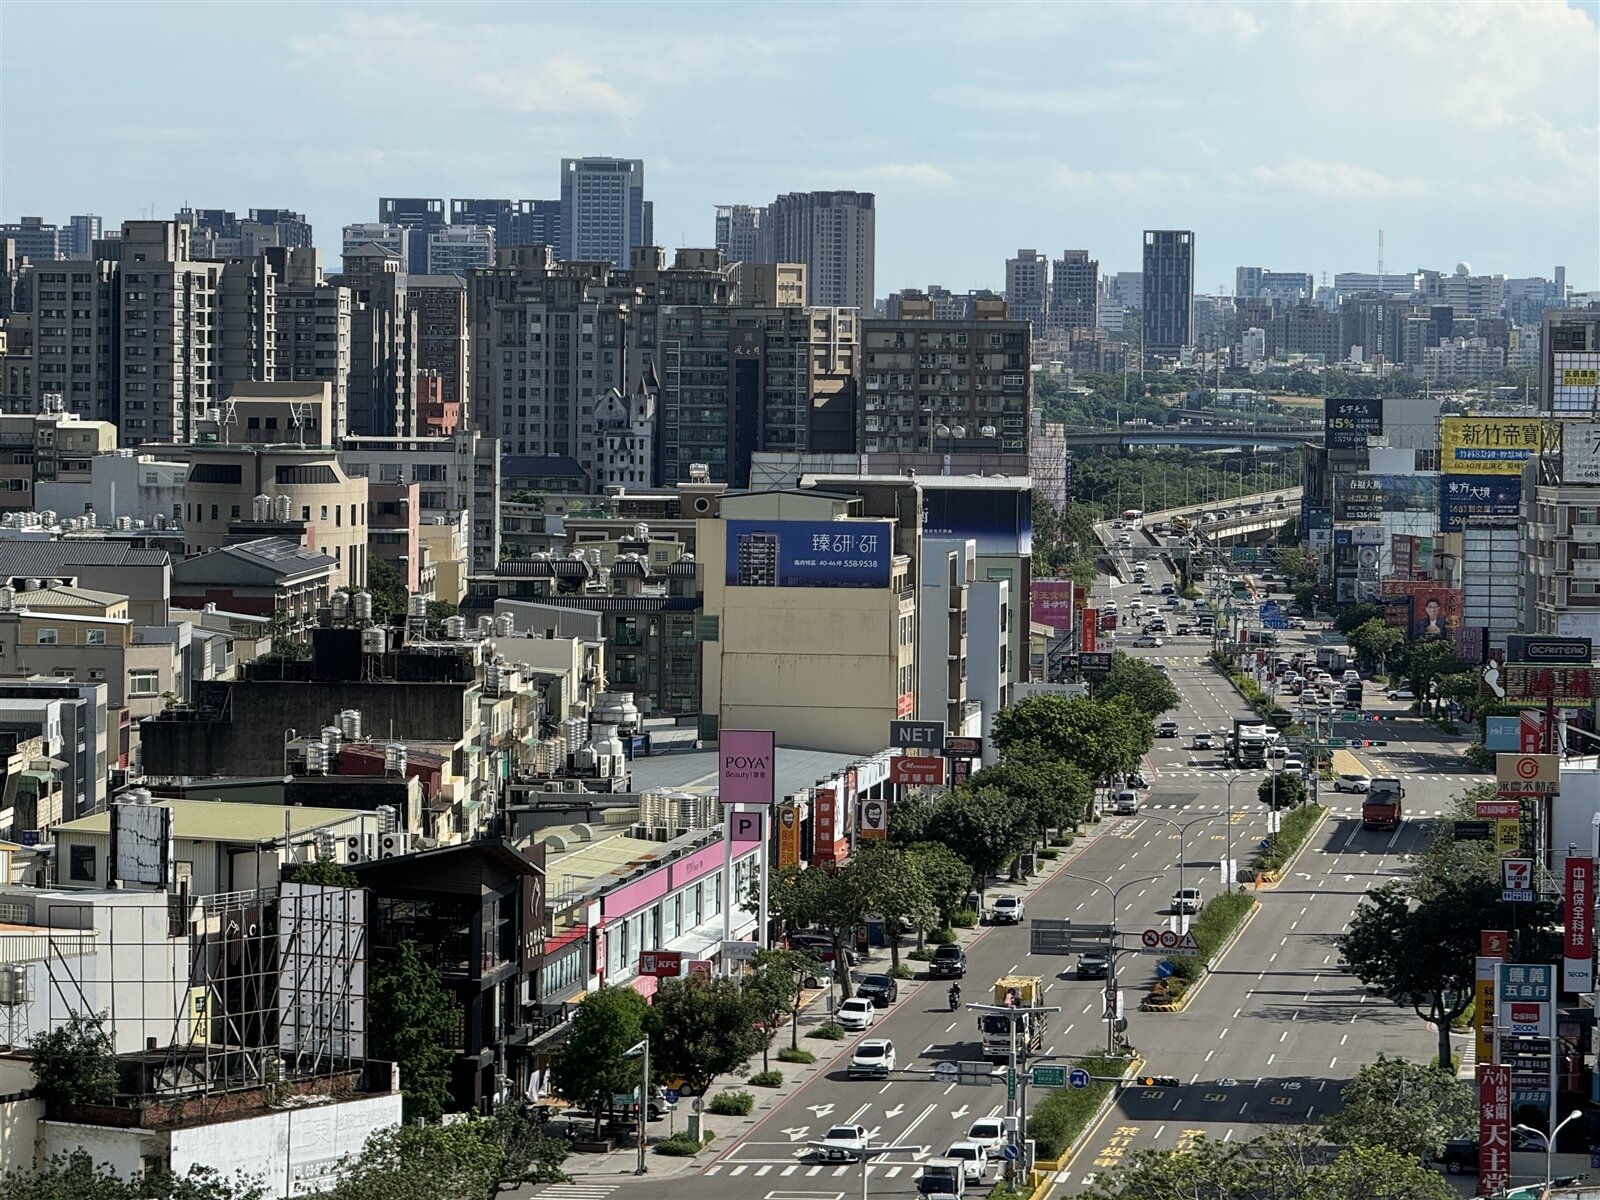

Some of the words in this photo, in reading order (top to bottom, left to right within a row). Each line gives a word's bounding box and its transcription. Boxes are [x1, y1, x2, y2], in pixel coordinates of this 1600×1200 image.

[1462, 423, 1540, 446] 新竹帝寶
[1448, 482, 1490, 500] 東方大境
[1357, 529, 1382, 539] 中油
[900, 728, 935, 742] NET
[726, 757, 766, 769] POYA
[726, 771, 750, 780] Beauty
[1499, 781, 1558, 792] 永慶不動產
[740, 819, 752, 834] P
[1572, 867, 1585, 946] 中興保全科技
[658, 960, 678, 968] KFC
[1505, 986, 1547, 997] 五金行
[1140, 1090, 1164, 1099] 50
[1203, 1093, 1227, 1102] 50
[1482, 1069, 1494, 1119] 六家
[1495, 1069, 1507, 1120] 小德蘭
[1269, 1096, 1292, 1105] 50
[1482, 1124, 1508, 1197] 天主堂
